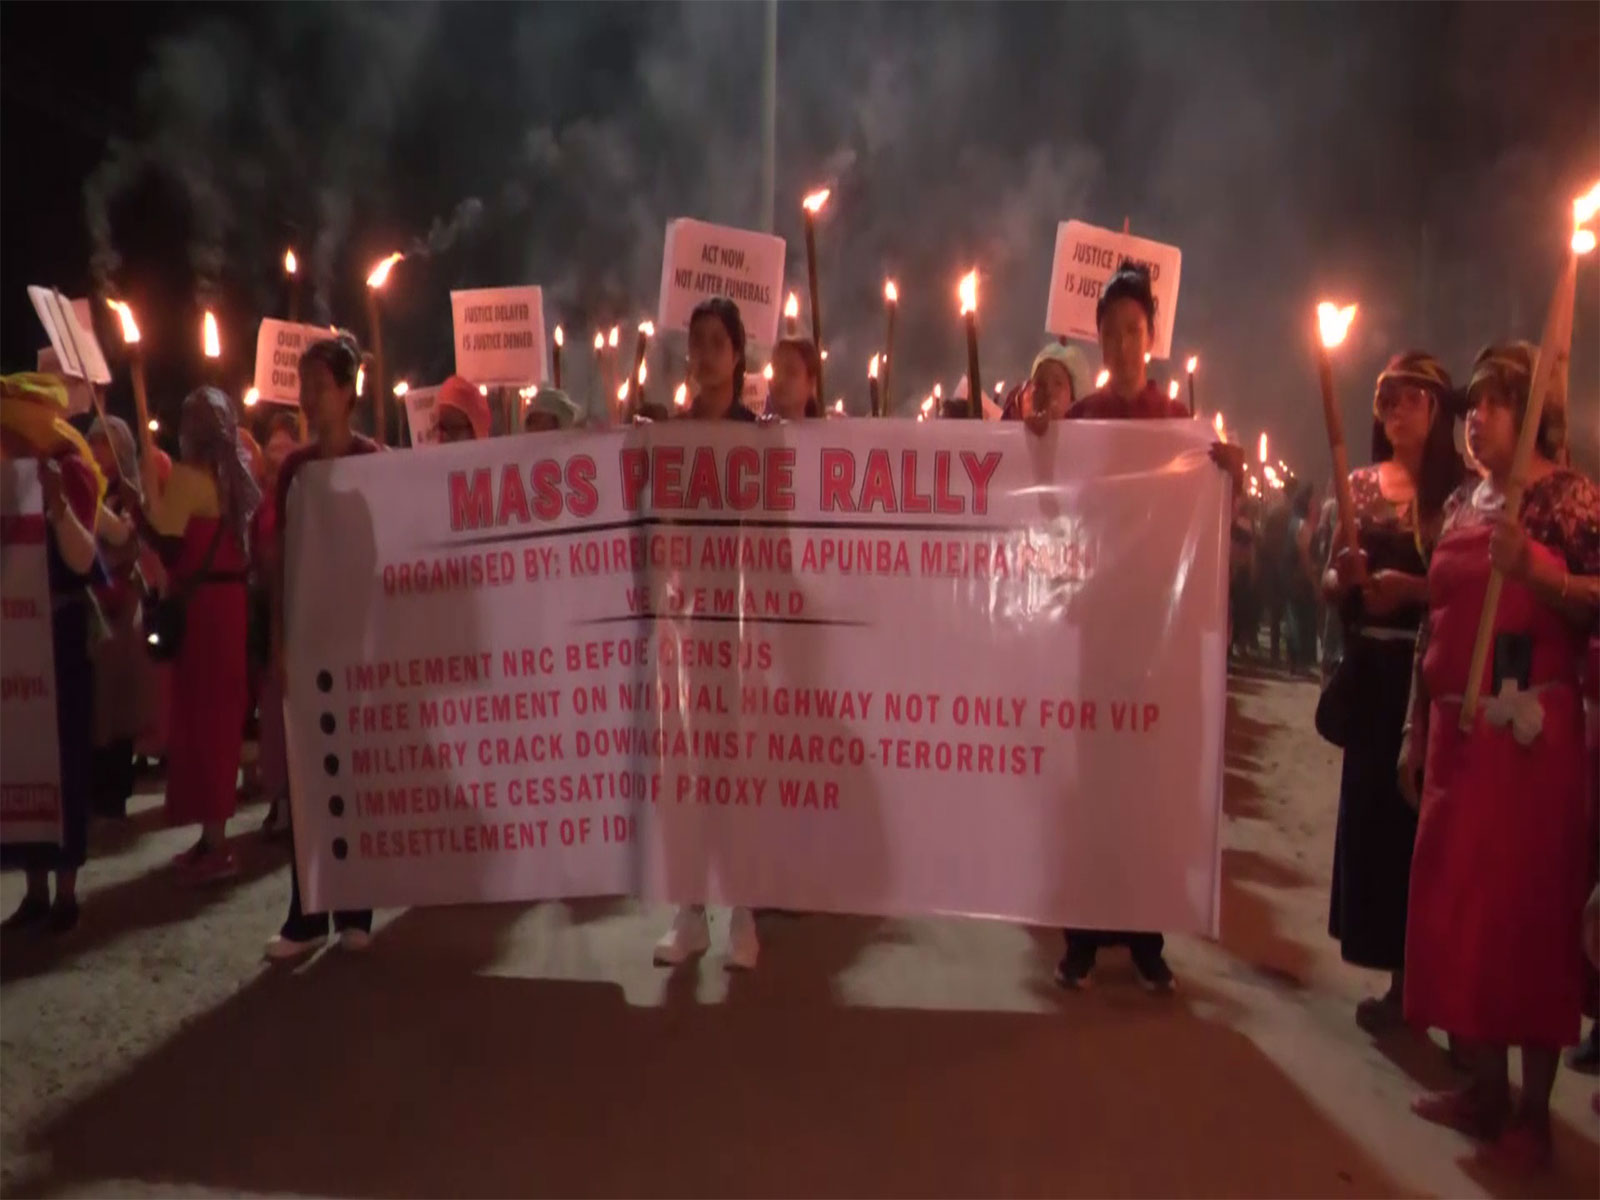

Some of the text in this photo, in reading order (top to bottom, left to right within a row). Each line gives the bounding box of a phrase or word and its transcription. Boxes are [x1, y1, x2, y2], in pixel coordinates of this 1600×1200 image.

[702, 243, 719, 265] ACT
[1072, 241, 1114, 270] JUSTICE
[675, 268, 693, 291] NOT
[695, 272, 722, 297] AFTER
[1064, 272, 1076, 293] IS
[464, 304, 493, 325] JUSTICE
[278, 330, 301, 348] OUR
[463, 333, 472, 352] IS
[273, 350, 298, 368] OUR
[271, 369, 297, 388] OUR
[448, 446, 1003, 531] MASS PEACE RALLY
[383, 550, 515, 597] ORGANISED
[700, 535, 794, 572] AWANG
[801, 538, 911, 575] APUNBA
[920, 541, 1010, 580] MEIRA
[345, 652, 493, 692] IMPLEMENT
[502, 647, 555, 678] NRC
[348, 703, 411, 734] FREE
[419, 690, 561, 729] MOVEMENT
[572, 684, 607, 716] ON
[740, 686, 874, 721] HIGHWAY
[884, 691, 941, 725] NOT
[951, 695, 1028, 728] ONLY
[1039, 698, 1098, 731] FOR
[1110, 702, 1161, 733] VIP
[352, 741, 468, 776] MILITARY
[477, 733, 565, 767] CRACK
[768, 731, 1046, 777] NARCO-TERORRIST
[356, 781, 498, 819] IMMEDIATE
[676, 773, 768, 806] PROXY
[778, 779, 840, 810] WAR
[359, 820, 549, 860] RESETTLEMENT
[559, 816, 592, 847] OF
